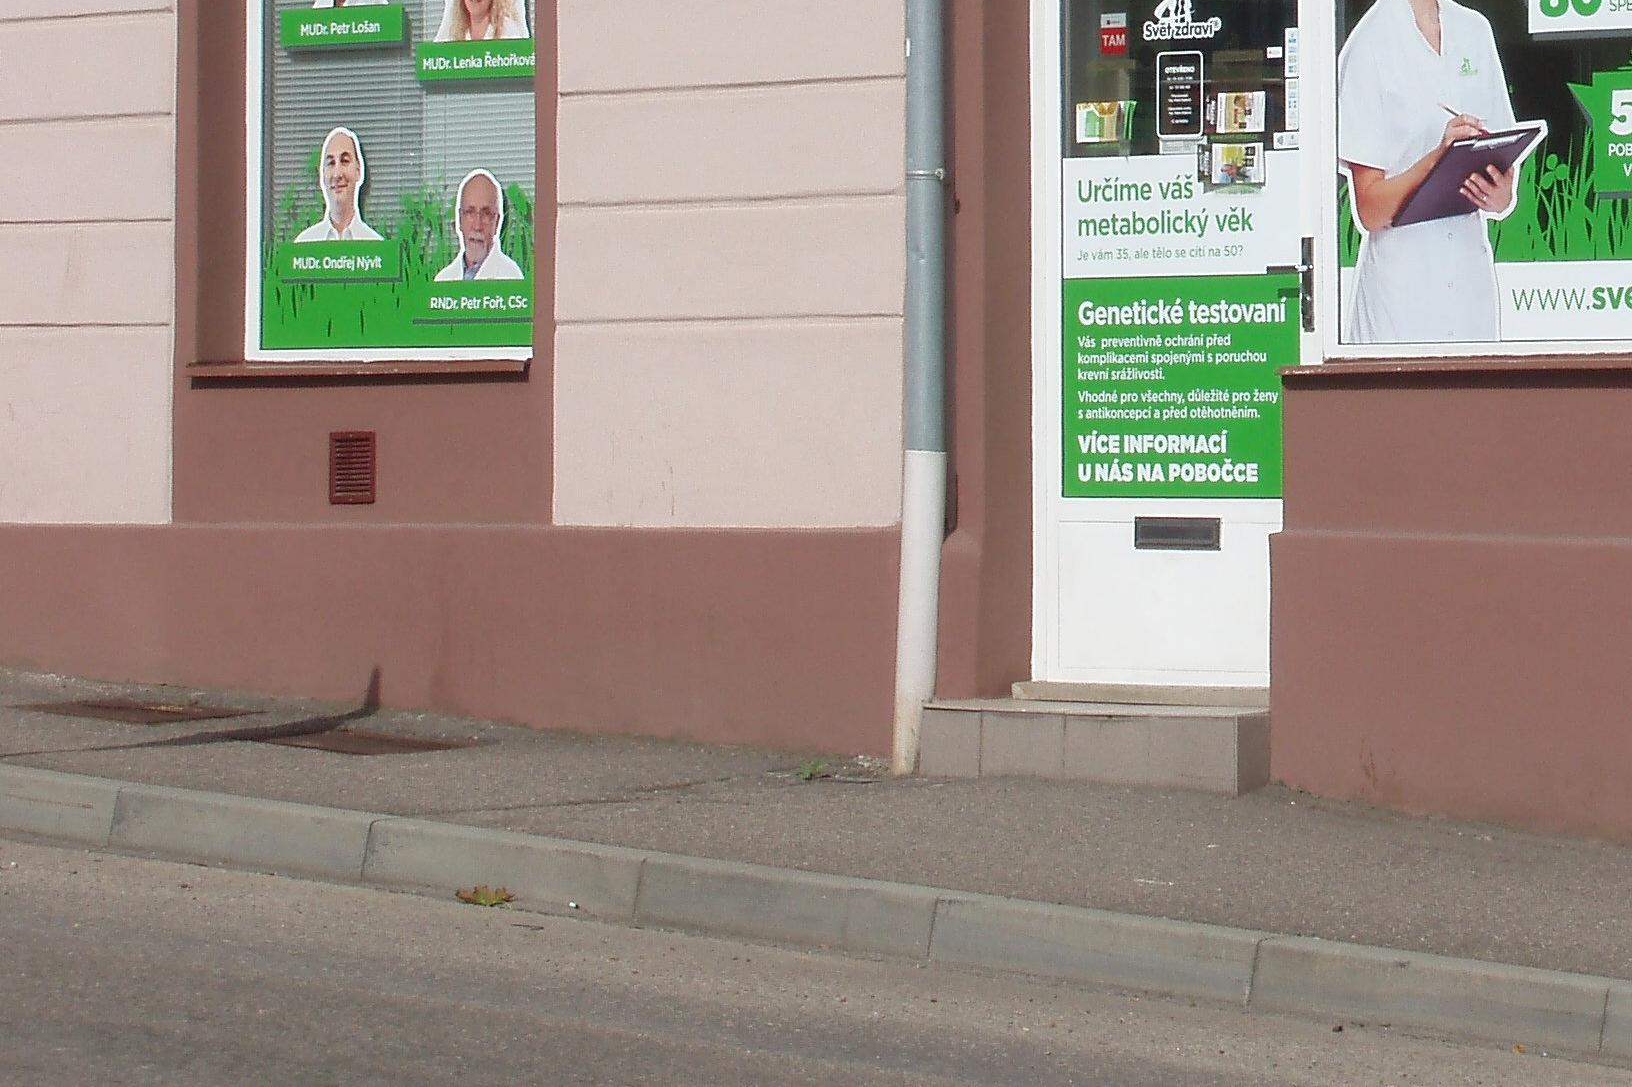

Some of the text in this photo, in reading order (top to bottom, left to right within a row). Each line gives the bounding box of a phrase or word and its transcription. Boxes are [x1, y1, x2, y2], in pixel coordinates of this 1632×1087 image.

[301, 20, 380, 36] MUDr. Petr Lošan
[1145, 24, 1171, 37] Svět
[1102, 34, 1125, 47] TAM
[423, 57, 451, 70] MUDr.
[454, 56, 482, 69] Lenka
[1078, 175, 1193, 203] Určíme váš
[1078, 207, 1254, 238] metabolický věk
[1077, 250, 1088, 261] Je
[1091, 249, 1112, 260] vám
[1135, 248, 1148, 259] ale
[1152, 247, 1172, 258] tělo
[1175, 249, 1186, 258] se
[1209, 248, 1220, 257] na
[1224, 245, 1243, 257] 50?
[293, 257, 320, 269] MUDr.
[323, 256, 355, 271] Ondřej
[430, 297, 459, 310] RNDr.
[461, 297, 480, 309] Petr
[509, 296, 528, 309] CSc
[1078, 297, 1286, 325] Genetické testovaní
[1078, 334, 1231, 349] Vás preventivně ochrání před
[1078, 350, 1267, 366] komplikacemi spojenými s poruchou
[1078, 367, 1165, 381] krevní srážlivosti.
[1078, 388, 1278, 404] Vhodné pro všechny, důležité pro ženy
[1078, 410, 1083, 419] s
[1154, 410, 1160, 419] a
[1163, 406, 1187, 420] před
[1190, 406, 1260, 419] otěhotněním.
[1078, 430, 1228, 453] VÍCE INFORMACÍ
[1078, 458, 1258, 482] U NÁS NA POBOČCE
